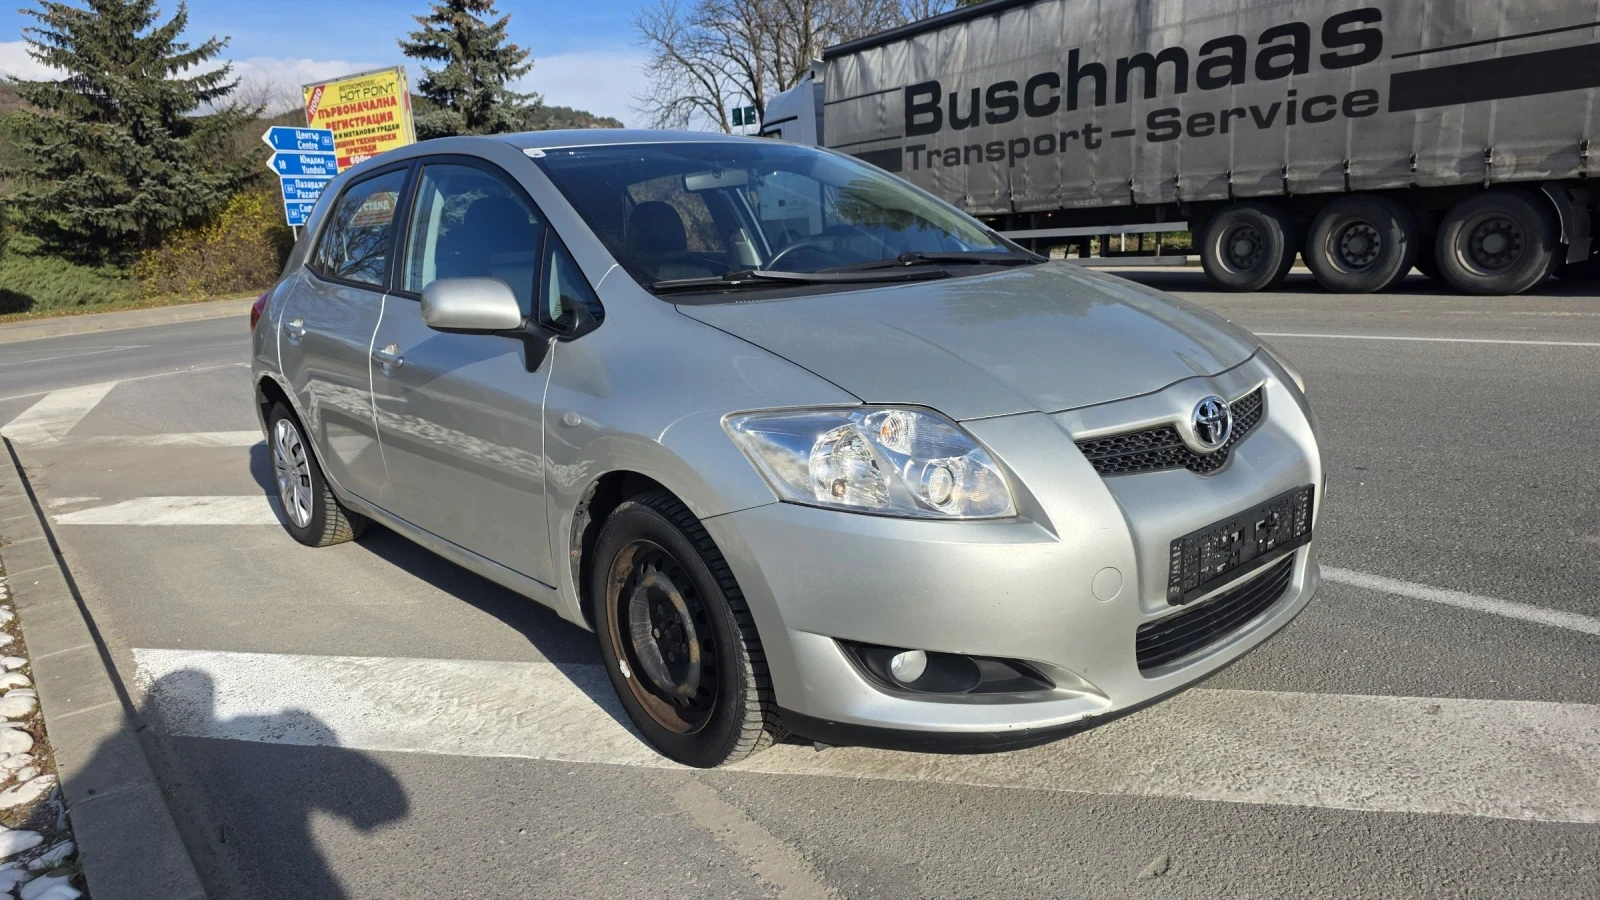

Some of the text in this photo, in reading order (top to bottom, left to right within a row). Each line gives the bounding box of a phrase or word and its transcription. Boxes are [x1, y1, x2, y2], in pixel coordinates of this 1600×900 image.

[905, 6, 1383, 138] Buschmaas
[340, 83, 395, 102] HOT POINT
[308, 87, 322, 115] НОВО
[318, 95, 397, 119] ПЪРВОНАЧАЛНА
[326, 111, 394, 131] РЕГИСТРАЦИЯ
[273, 130, 319, 144] 1 Център
[343, 128, 376, 138] МЕТАНОВИ
[377, 124, 400, 133] УРЕДБИ
[297, 141, 318, 150] Centre
[356, 133, 397, 146] ТЕХНИЧЕСКИ
[278, 155, 324, 169] 18 Юндола
[301, 165, 326, 174] Yundola
[295, 179, 327, 190] Пазардж
[296, 190, 320, 199] Pazard
